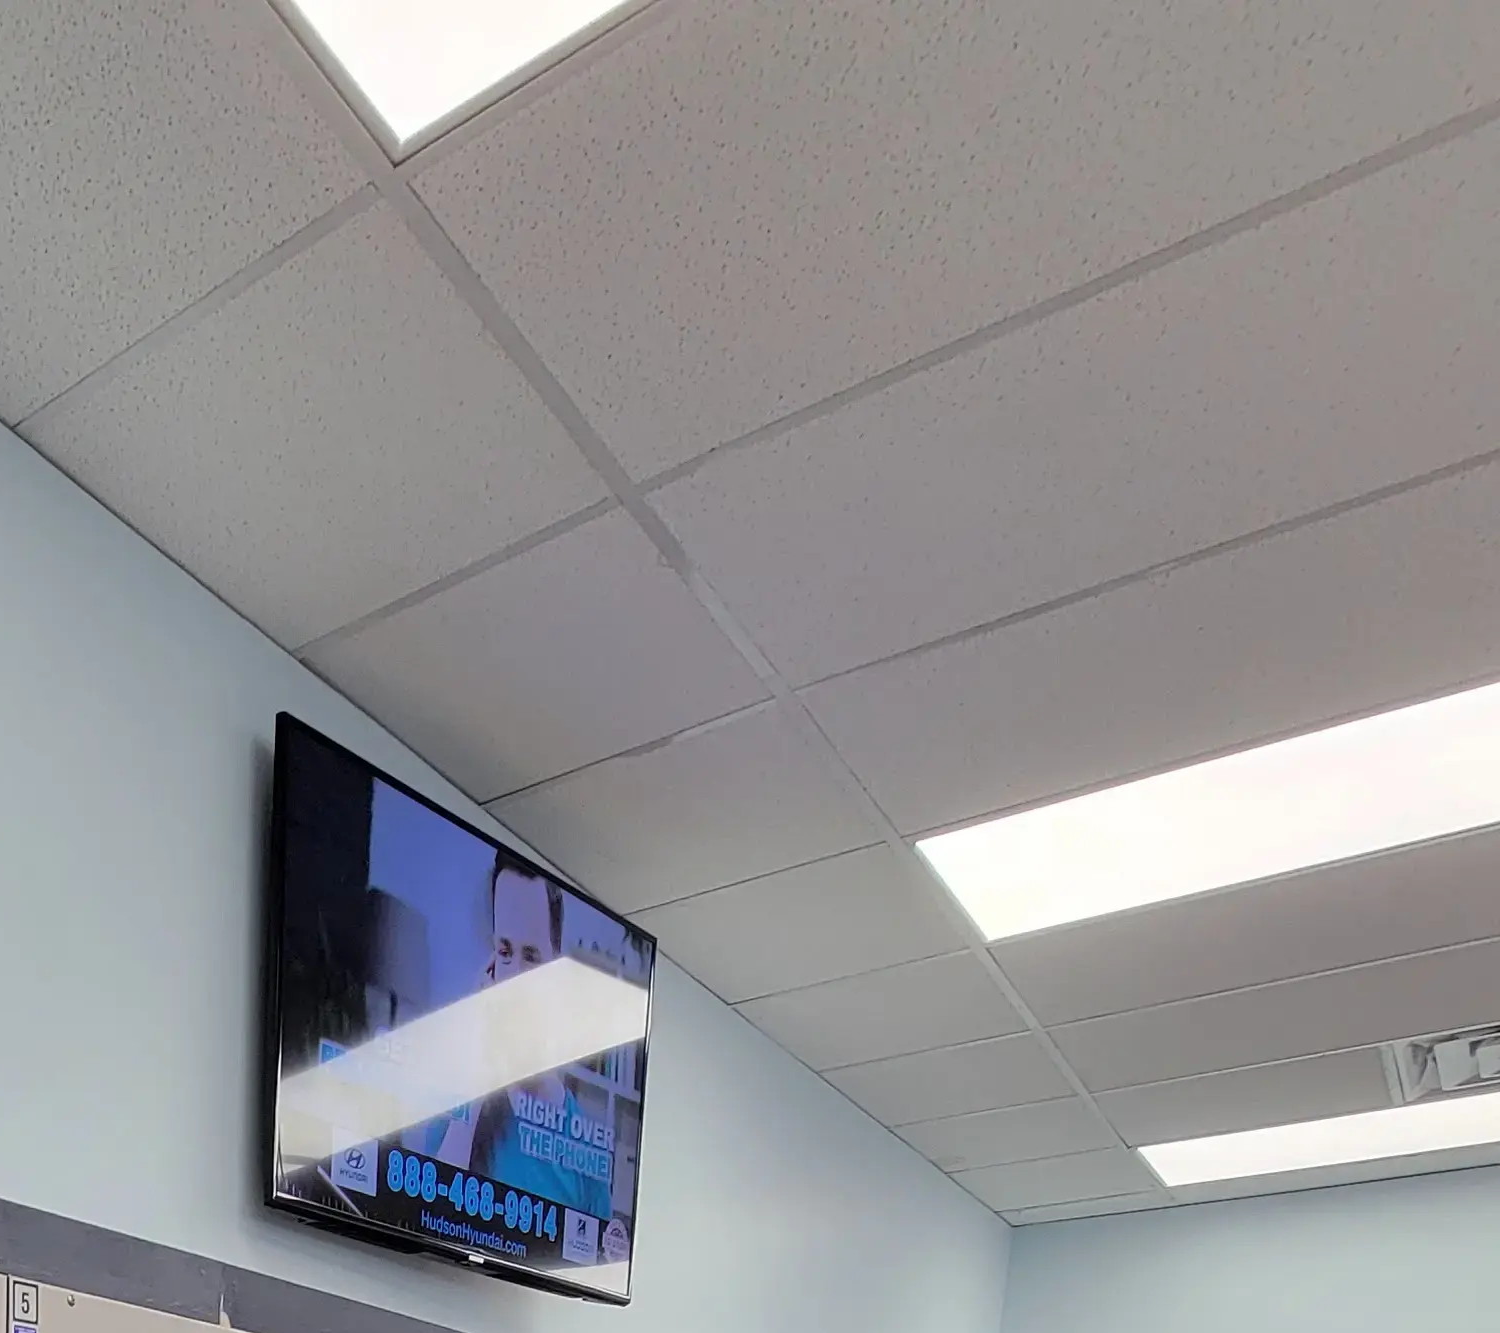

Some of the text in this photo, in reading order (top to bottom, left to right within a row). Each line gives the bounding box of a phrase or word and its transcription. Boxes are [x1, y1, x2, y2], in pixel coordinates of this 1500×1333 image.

[516, 1093, 615, 1152] RIGHT OVER
[519, 1121, 613, 1182] THE PHONE
[387, 1150, 557, 1242] 888-468-9914
[420, 1209, 527, 1260] HudsonHyundai.com
[21, 1292, 30, 1314] 5
